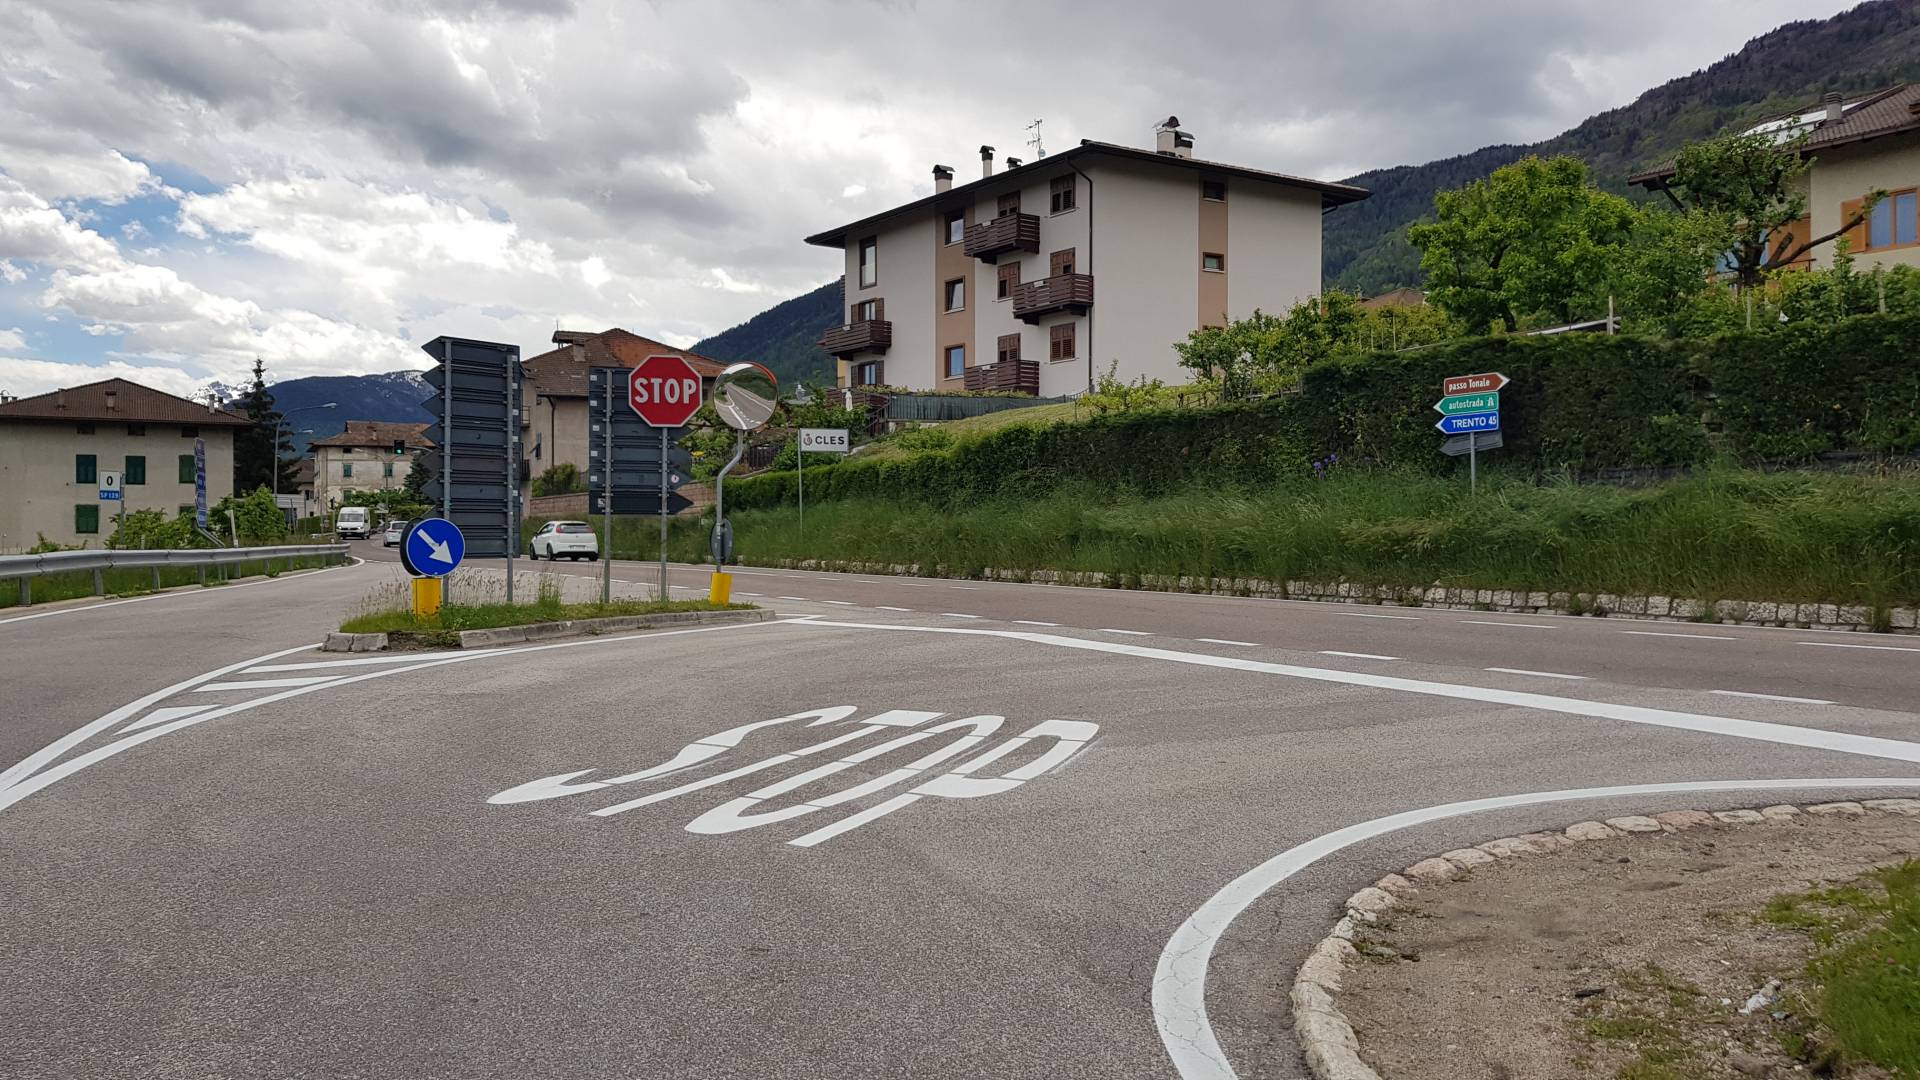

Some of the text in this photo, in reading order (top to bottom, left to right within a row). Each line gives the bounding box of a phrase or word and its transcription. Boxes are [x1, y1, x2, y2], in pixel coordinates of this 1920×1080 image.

[635, 378, 697, 405] STOP
[1448, 378, 1490, 393] passo Tonale
[1448, 398, 1484, 409] autostrada
[1451, 415, 1497, 428] TRENTO 45
[815, 435, 845, 445] CLES
[106, 475, 113, 486] 0
[486, 705, 1100, 847] STOP
